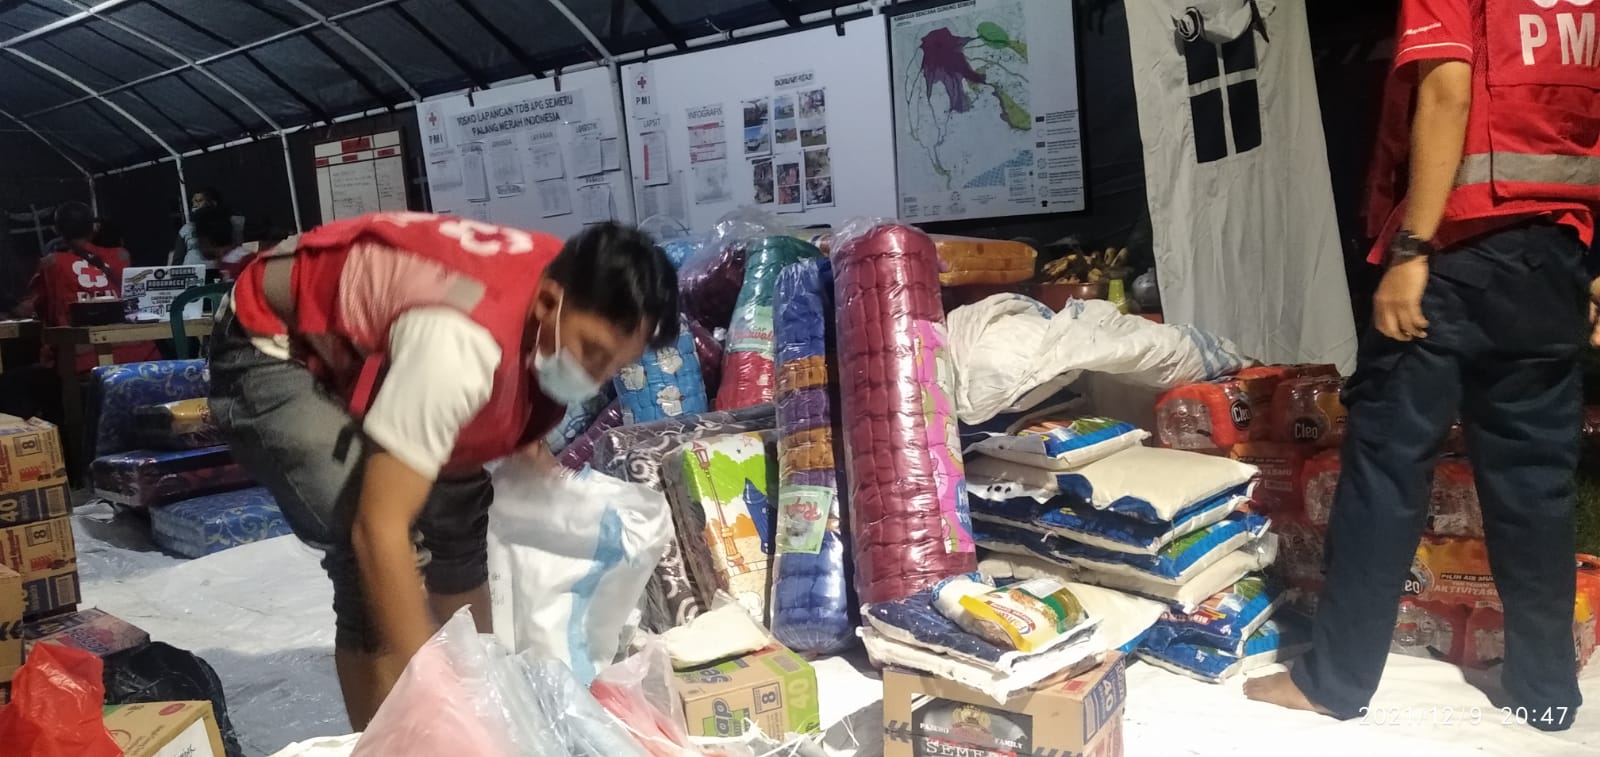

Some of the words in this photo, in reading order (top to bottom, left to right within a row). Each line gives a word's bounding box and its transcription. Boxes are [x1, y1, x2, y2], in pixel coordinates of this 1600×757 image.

[1519, 12, 1600, 67] PM
[635, 95, 651, 105] PMI
[477, 106, 514, 123] LAPANGAN
[471, 123, 499, 136] PALANG
[499, 117, 523, 132] MERAH
[524, 111, 561, 126] INDONESIA
[428, 134, 444, 145] PMI
[1294, 423, 1318, 439] Cleo
[22, 440, 35, 449] 8
[0, 498, 18, 523] 40
[34, 529, 46, 539] 8
[761, 691, 776, 704] 8
[787, 677, 809, 709] 40
[1102, 679, 1114, 712] 40
[994, 737, 1024, 750] FAMILY
